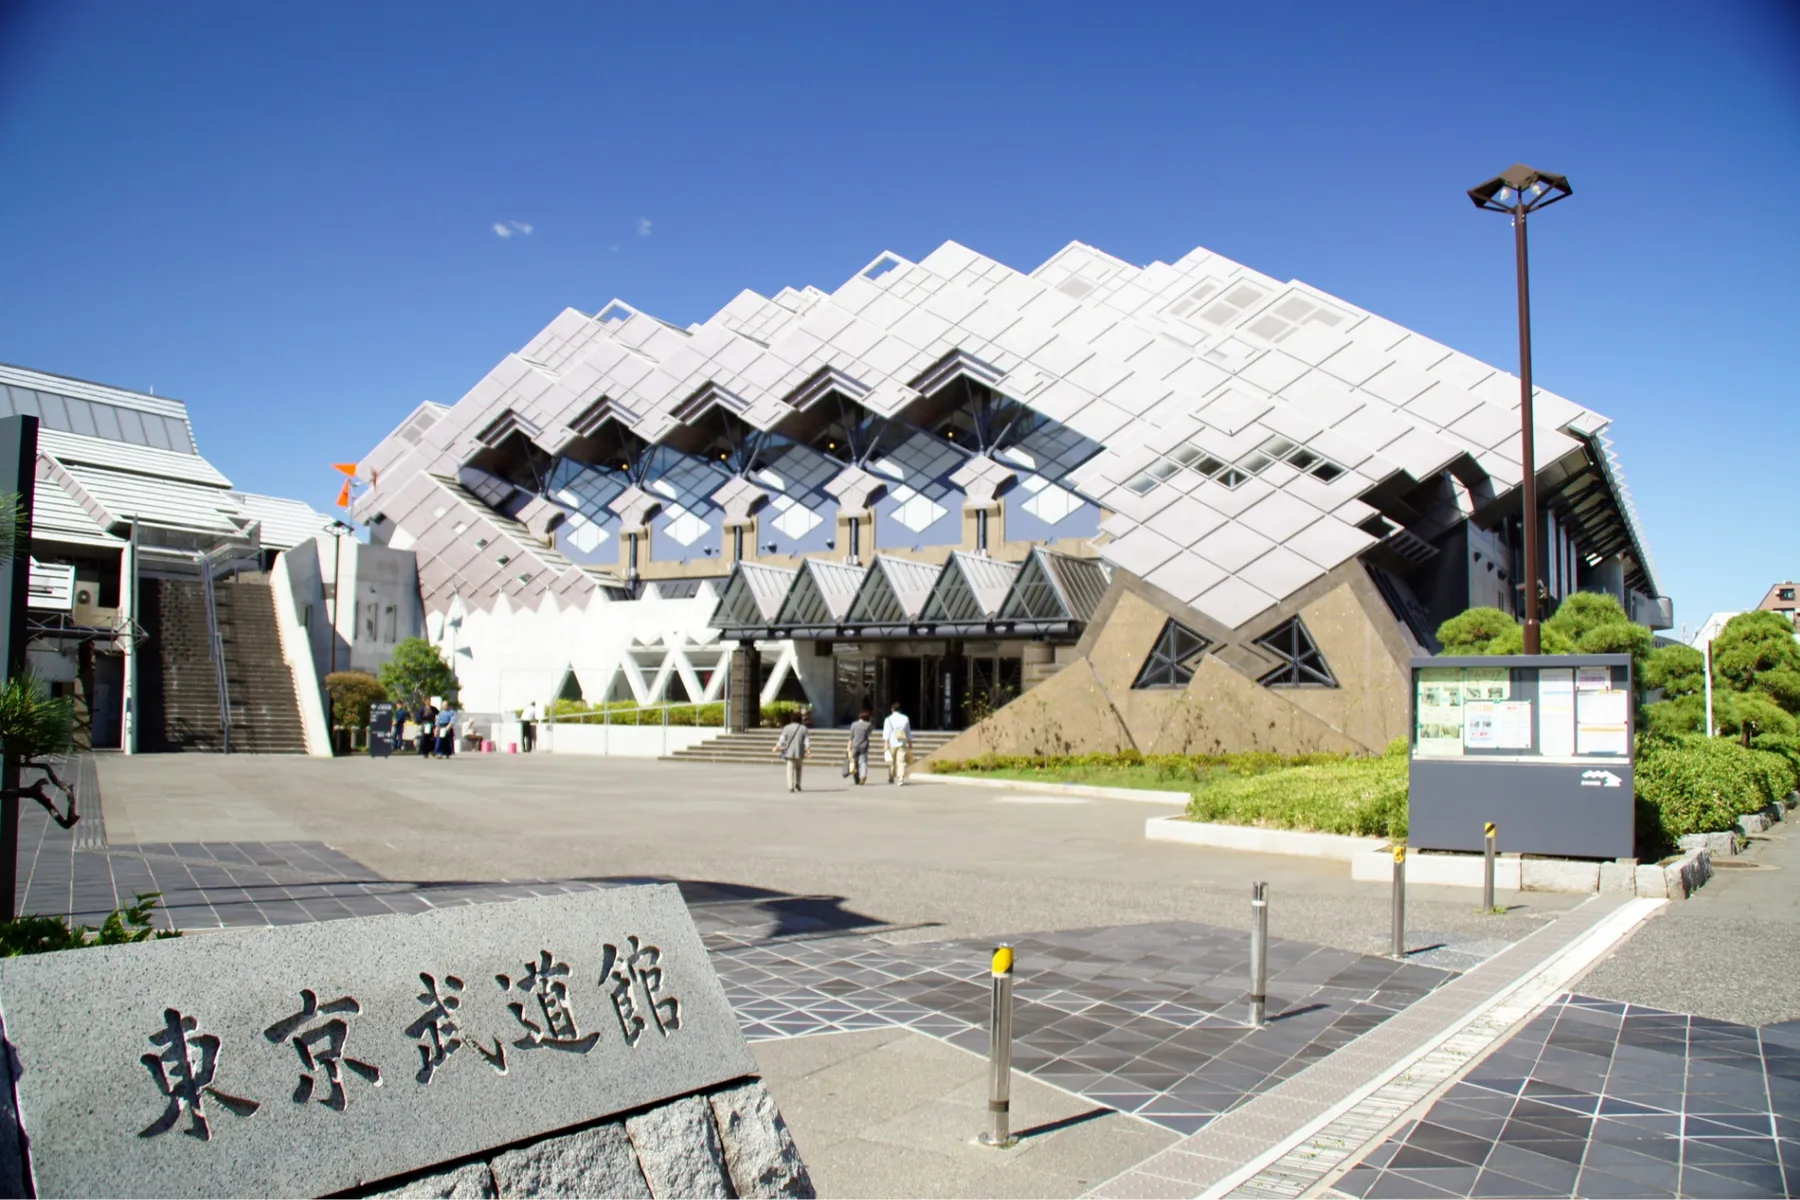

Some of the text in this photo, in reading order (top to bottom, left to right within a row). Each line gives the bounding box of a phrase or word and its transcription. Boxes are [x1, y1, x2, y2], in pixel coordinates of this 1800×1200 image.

[139, 935, 681, 1142] 東京武道館
